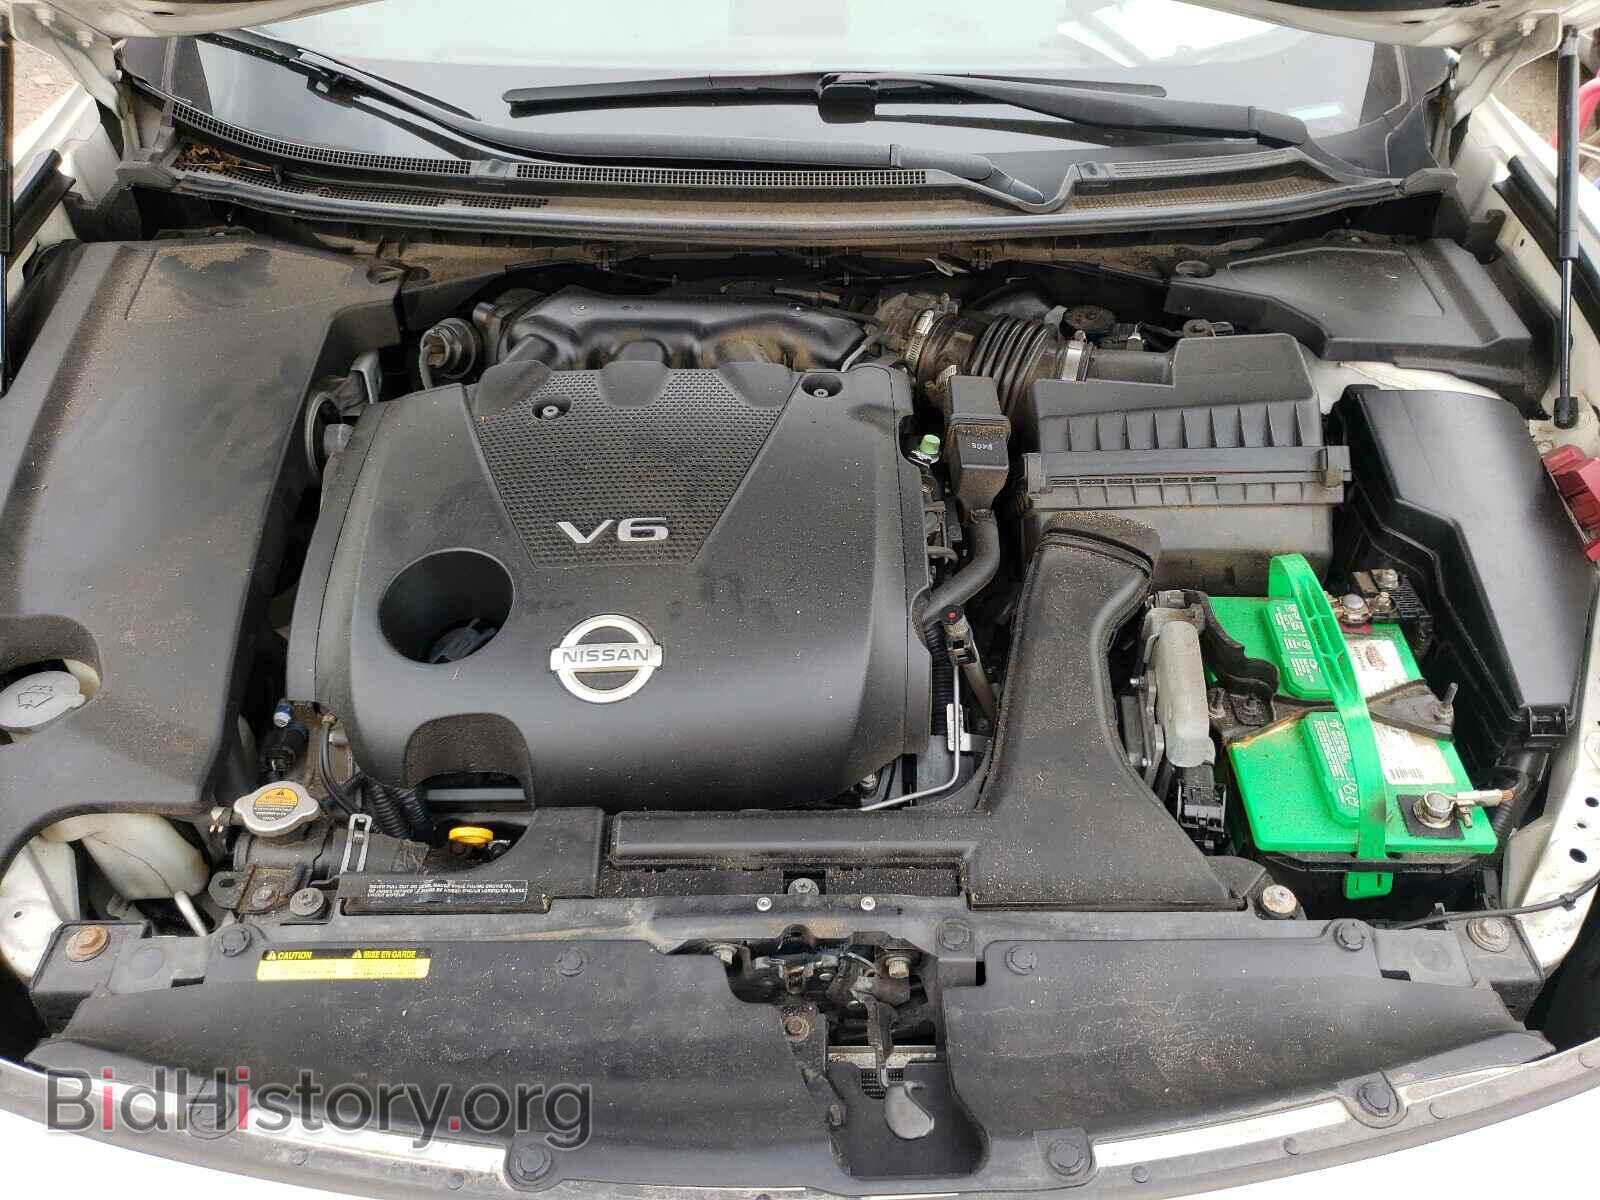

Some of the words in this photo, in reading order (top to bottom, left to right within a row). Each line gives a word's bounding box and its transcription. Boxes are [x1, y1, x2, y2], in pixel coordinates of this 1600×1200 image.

[556, 516, 669, 543] V6
[563, 648, 649, 662] NISSAN
[278, 951, 313, 961] CAUTION
[381, 950, 391, 959] EN
